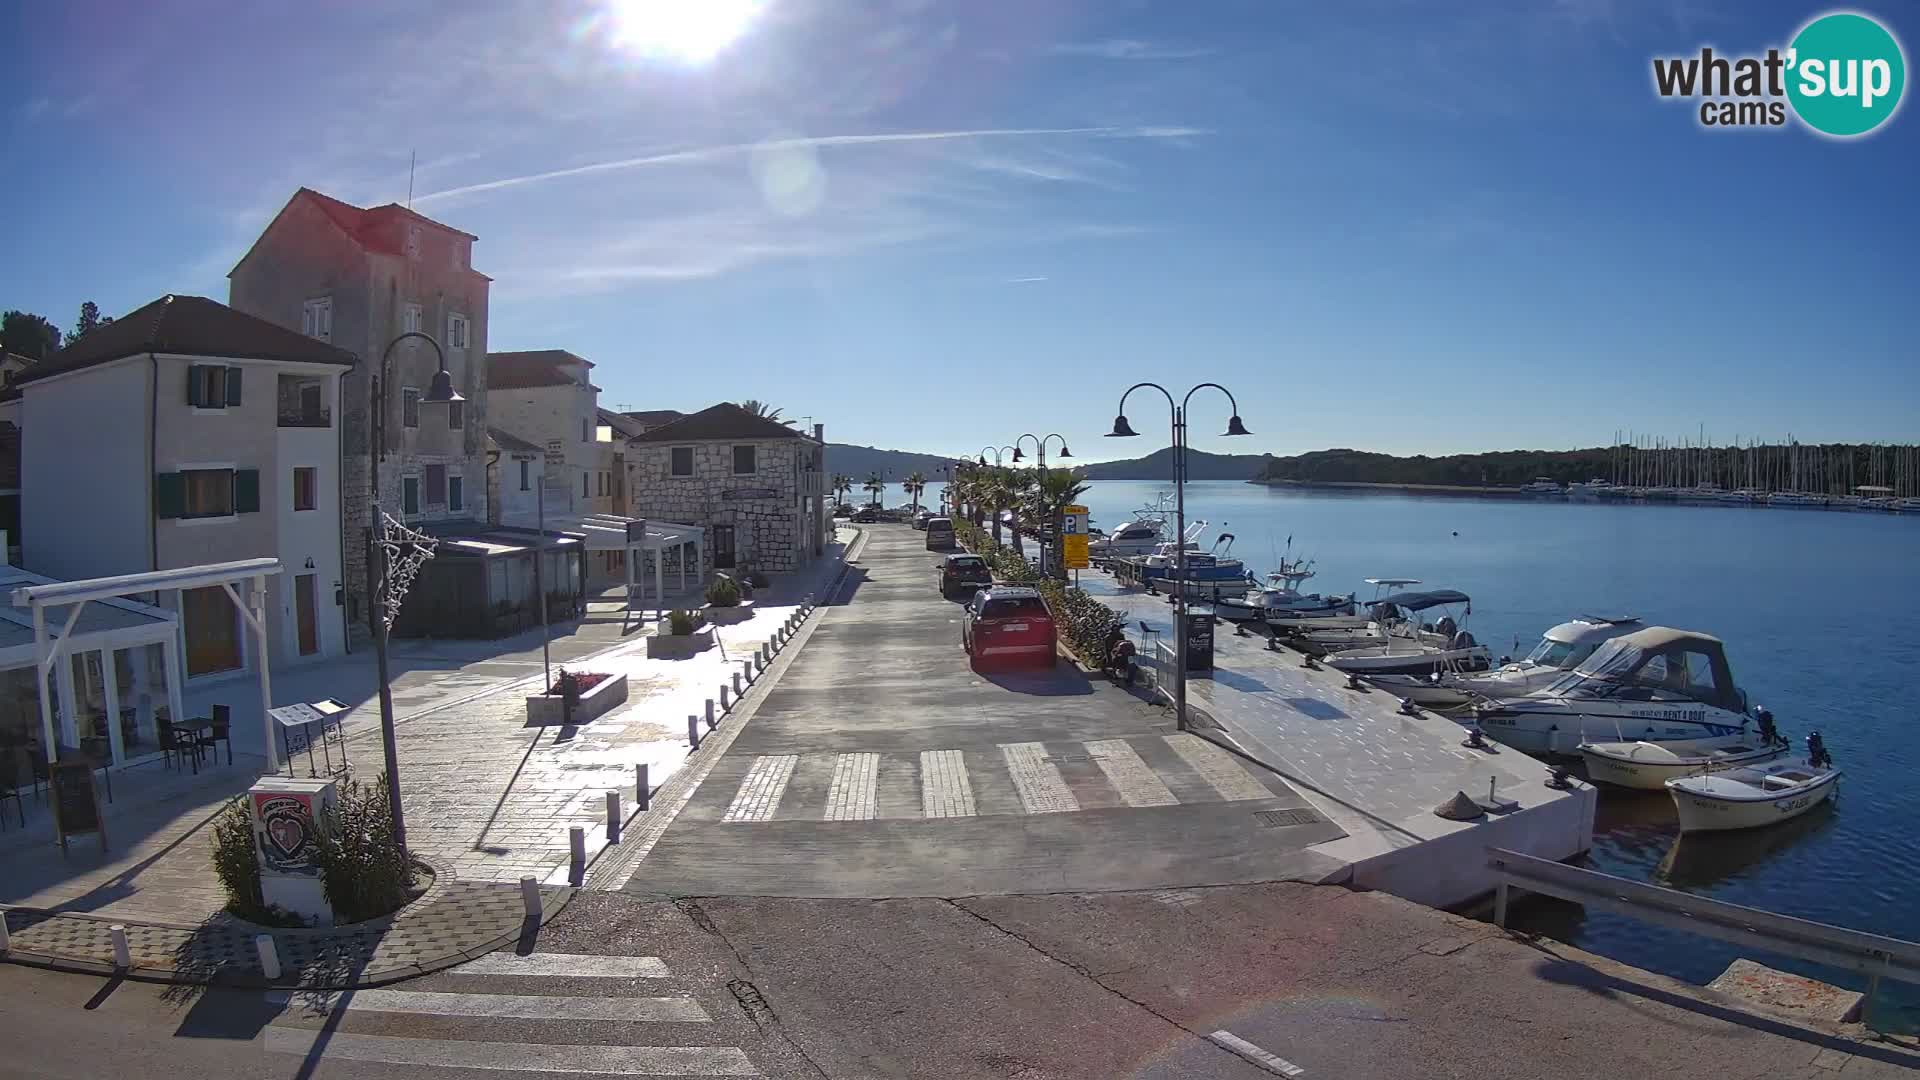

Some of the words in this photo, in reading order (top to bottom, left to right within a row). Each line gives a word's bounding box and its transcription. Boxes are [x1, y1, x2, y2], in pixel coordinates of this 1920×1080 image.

[1065, 516, 1076, 532] P
[1663, 710, 1682, 720] RENT
[1689, 710, 1706, 721] BOAT
